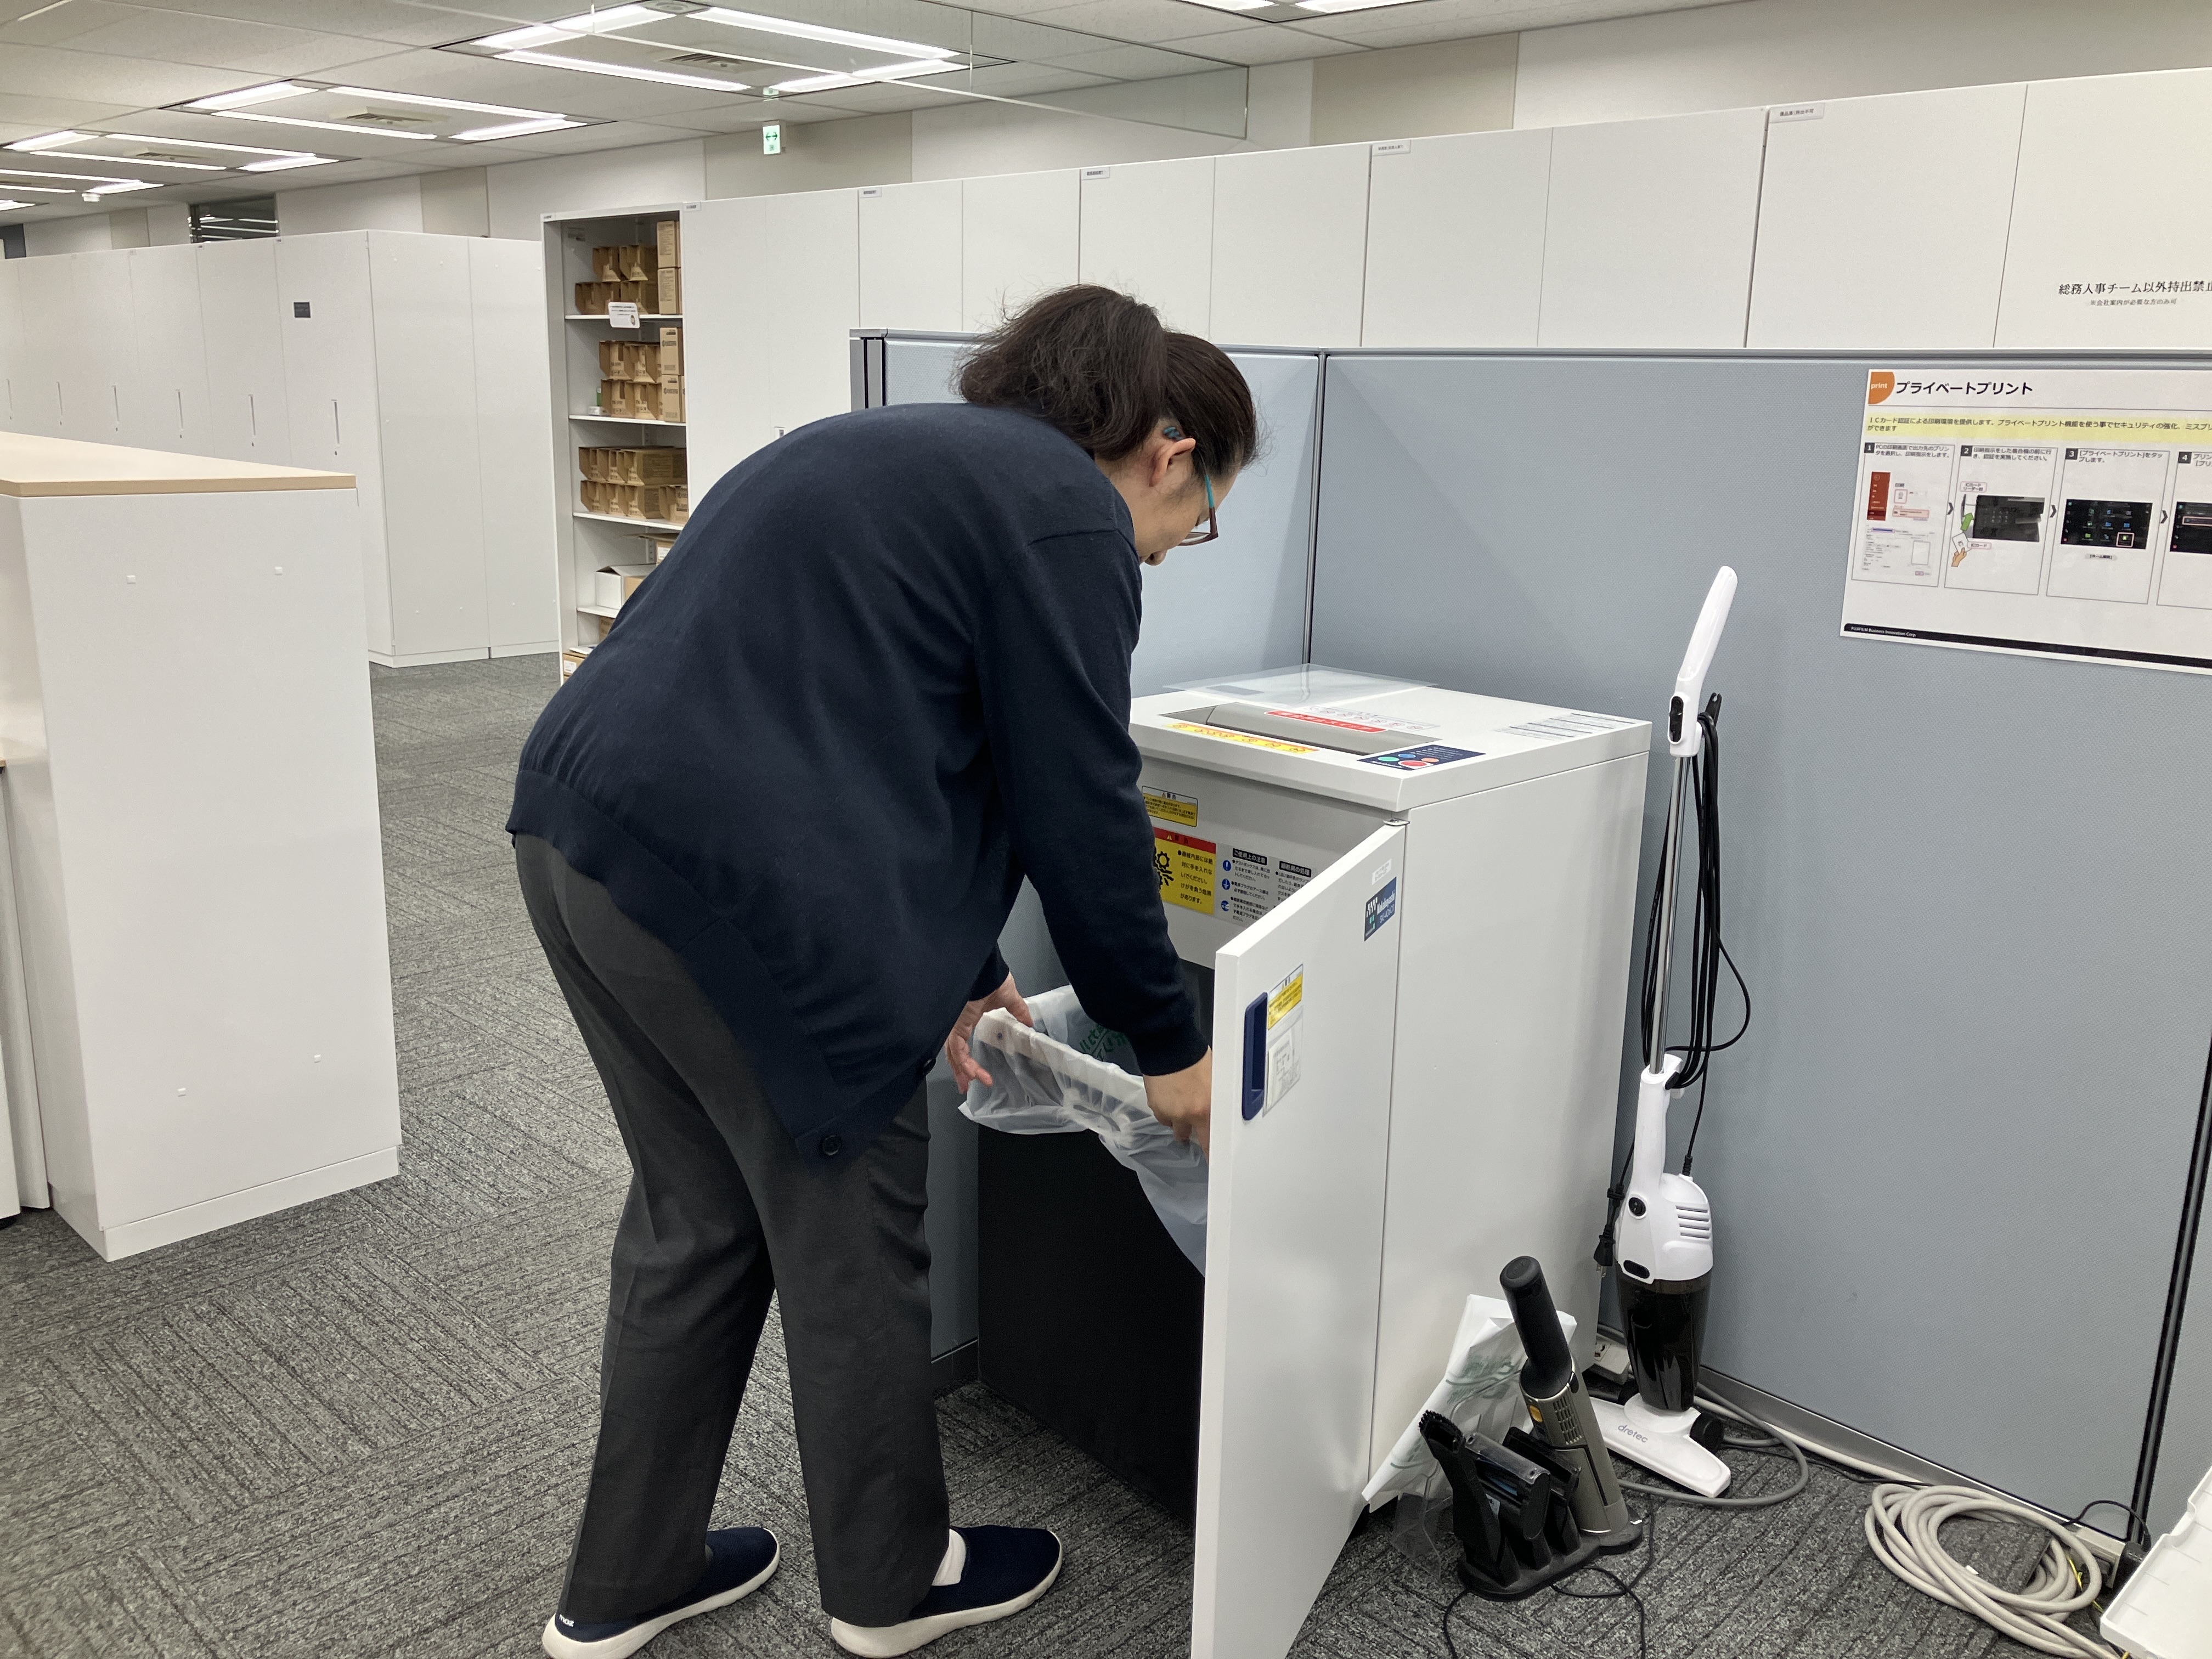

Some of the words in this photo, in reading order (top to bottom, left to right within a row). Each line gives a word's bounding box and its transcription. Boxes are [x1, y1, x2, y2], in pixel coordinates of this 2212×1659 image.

[1897, 381, 2033, 394] プライベートプリント
[1181, 861, 1212, 875] 対に手を入れな
[1181, 872, 1208, 885] いでください。
[1180, 882, 1212, 897] けがを負う危険
[1180, 892, 1203, 905] があります。
[1618, 1425, 1648, 1443] dretec
